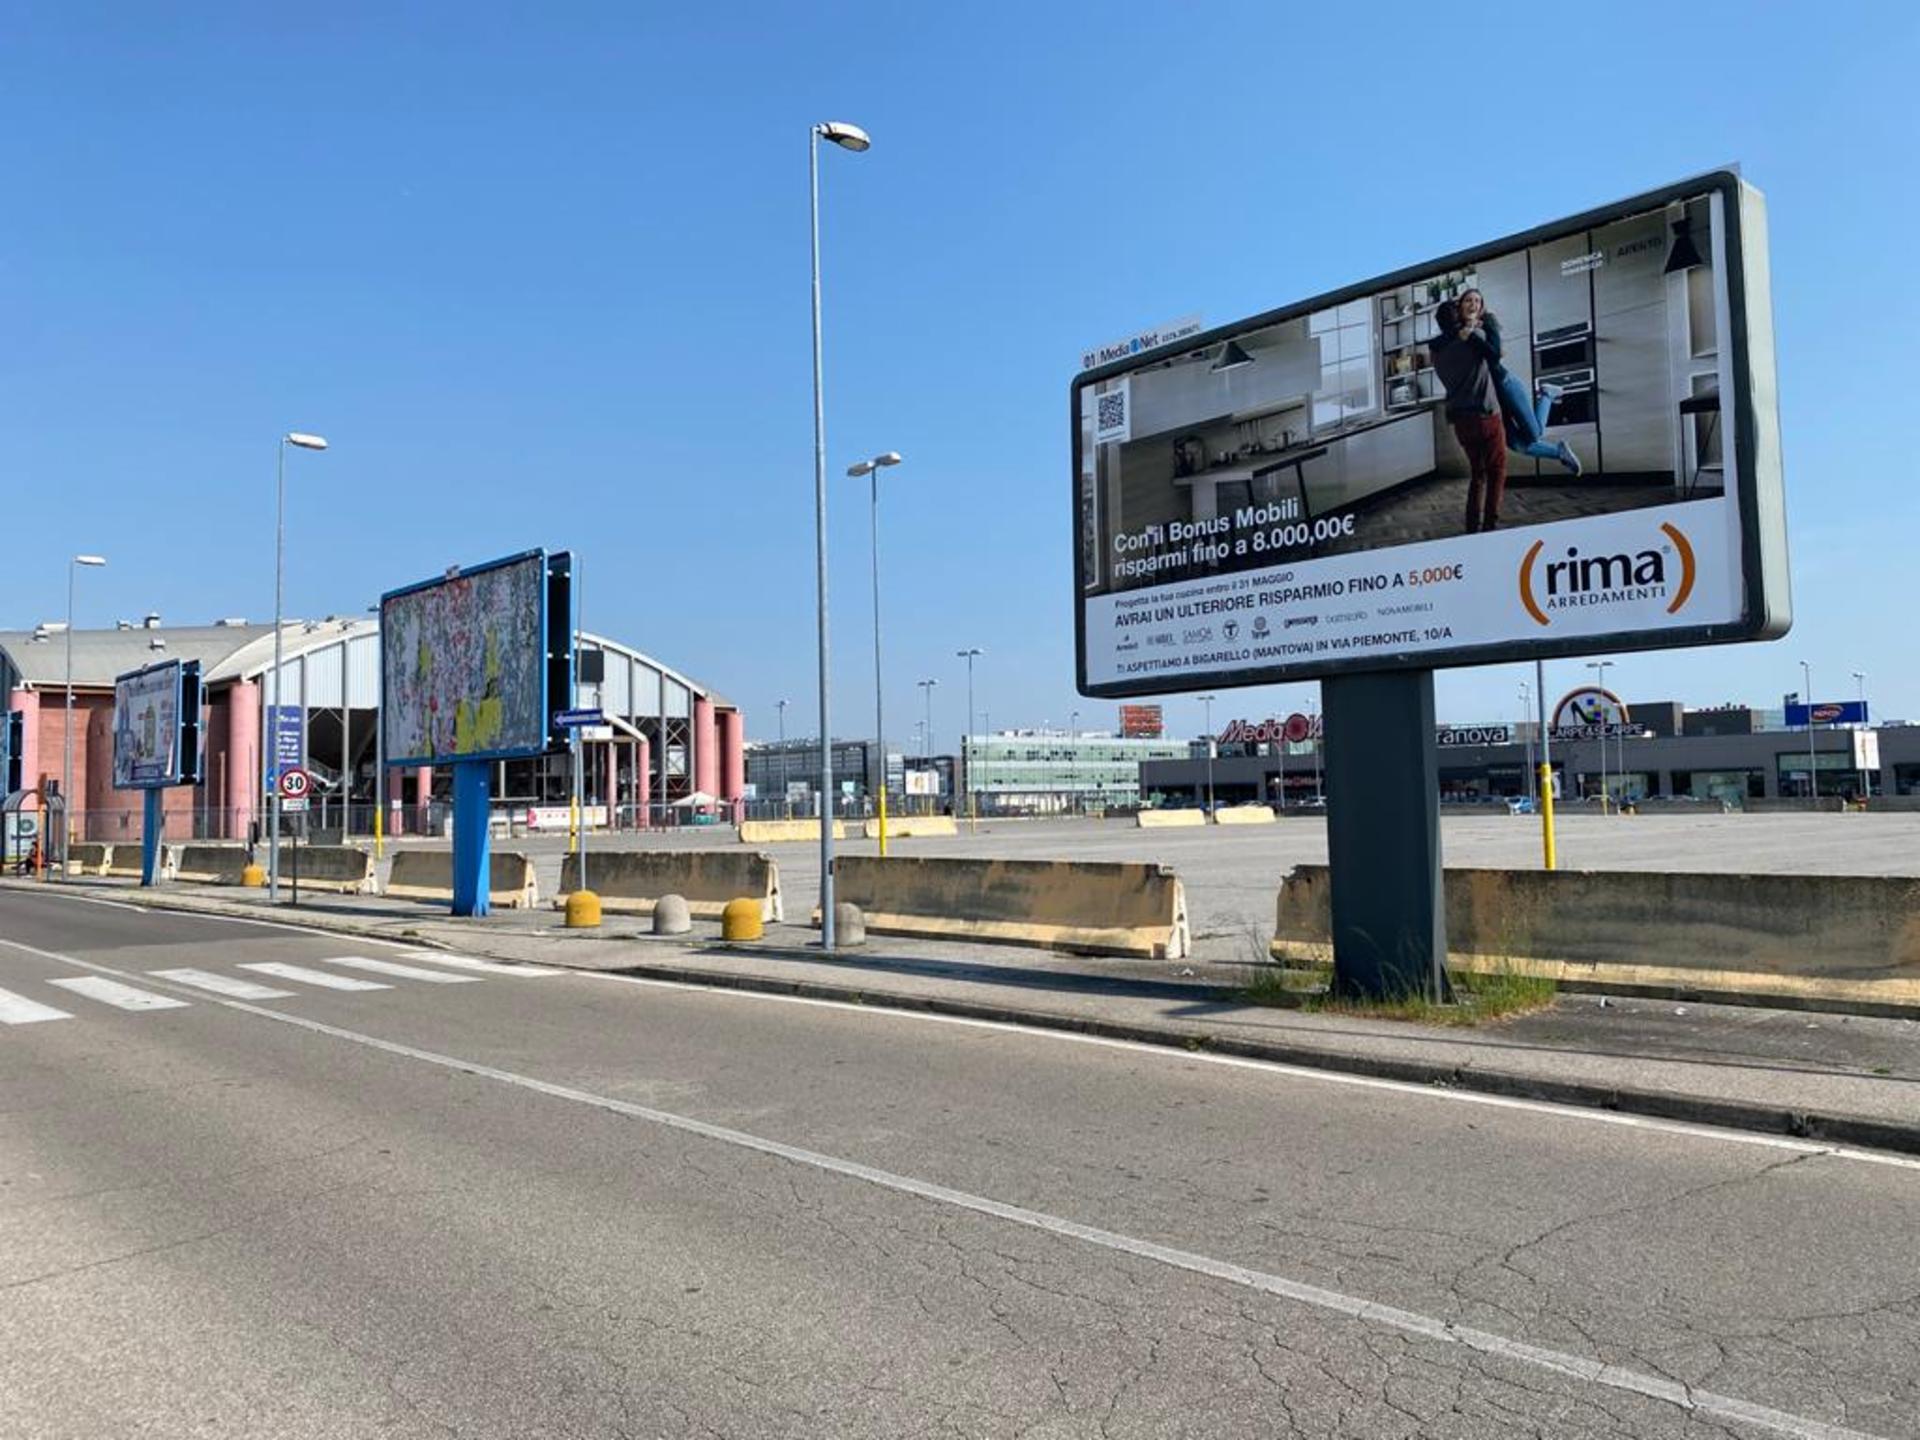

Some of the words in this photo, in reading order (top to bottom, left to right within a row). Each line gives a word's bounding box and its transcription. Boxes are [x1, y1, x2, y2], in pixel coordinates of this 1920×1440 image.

[1115, 533, 1148, 553] Con
[1153, 525, 1163, 545] il
[1169, 516, 1229, 542] Bonus
[1235, 498, 1298, 528] Mobili
[1114, 550, 1187, 578] risparmi
[1192, 540, 1229, 563] fino
[1234, 538, 1247, 555] a
[1252, 514, 1355, 552] 8.000,00€
[1206, 583, 1229, 594] entro
[1239, 578, 1249, 588] 31
[1252, 571, 1293, 586] MAGGIO
[1546, 546, 1665, 595] rima
[1115, 610, 1151, 627] AVRAI
[1154, 606, 1174, 621] UN
[1176, 593, 1254, 618] ULTERIORE
[1259, 580, 1344, 606] RISPARMIO
[1348, 574, 1387, 594] FINO
[1392, 572, 1404, 587] A
[1547, 587, 1665, 609] ARREDAMENTI
[1126, 657, 1181, 672] ASPETTIAMO
[1192, 648, 1250, 664] BIGARELLO
[1316, 640, 1328, 651] IN
[1330, 637, 1350, 649] VIA
[1352, 629, 1420, 648] PIEMONTE,
[1424, 625, 1452, 640] 10/A
[1219, 719, 1284, 743] Media
[1549, 723, 1643, 738] ARPE&SCARPE
[286, 777, 304, 790] 30
